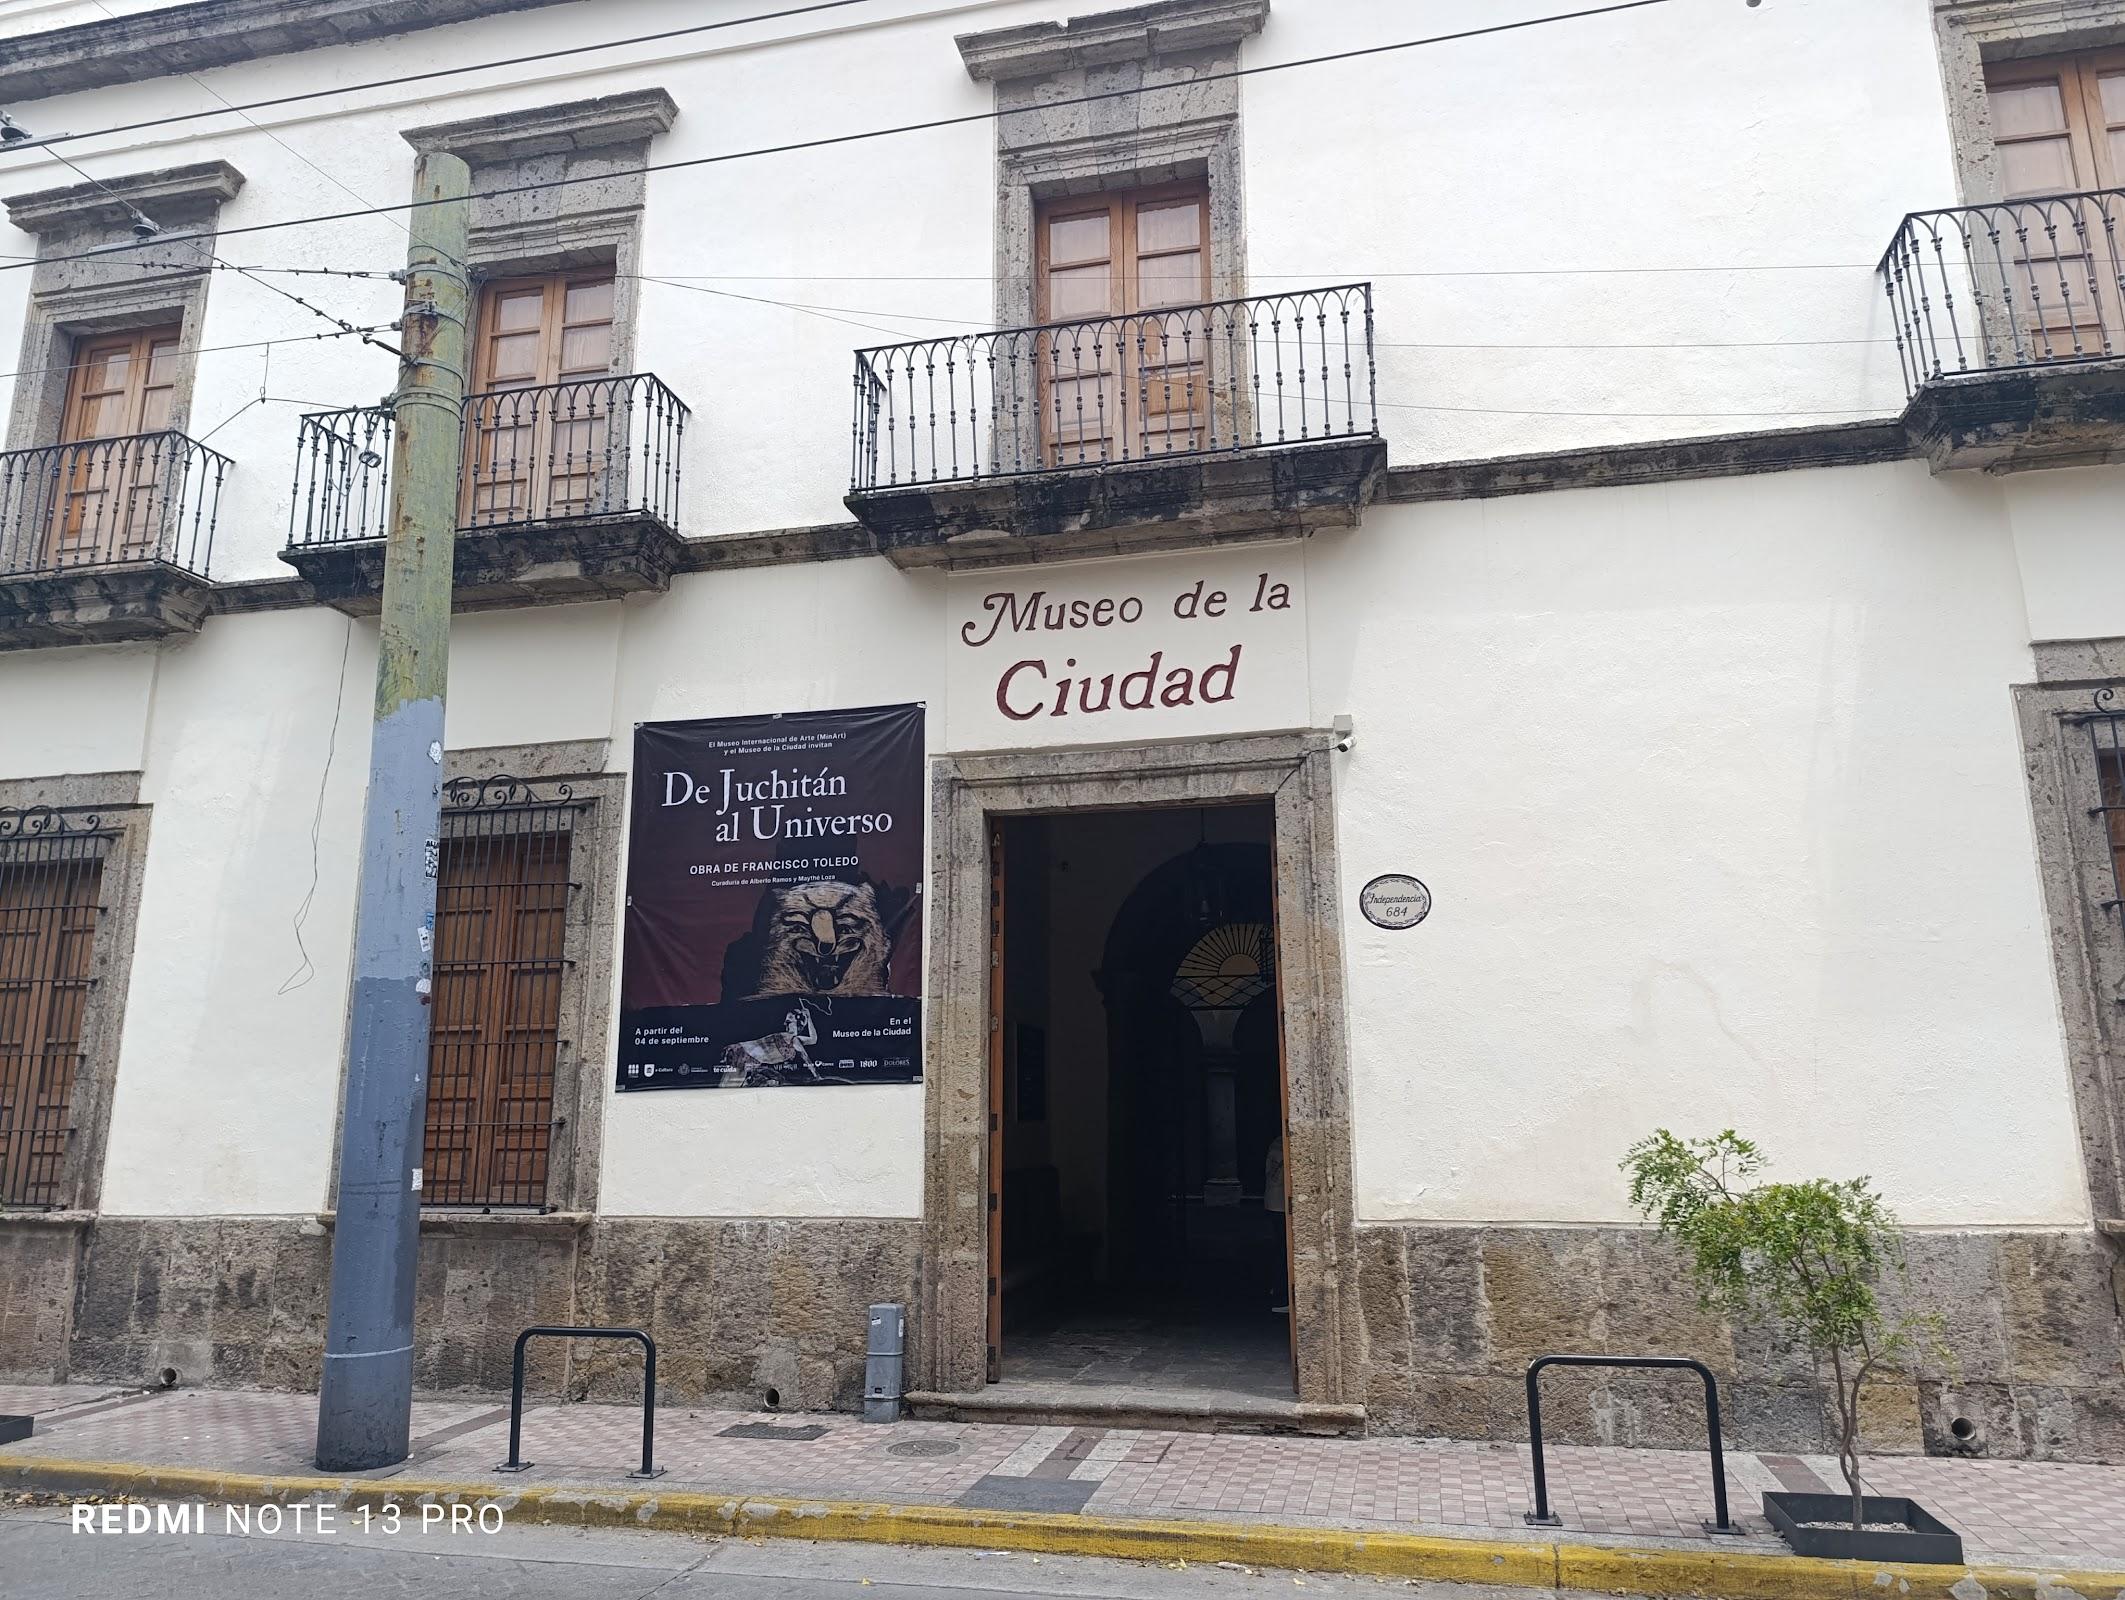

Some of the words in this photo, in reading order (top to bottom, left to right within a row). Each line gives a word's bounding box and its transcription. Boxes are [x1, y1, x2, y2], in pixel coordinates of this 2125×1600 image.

[962, 591, 1143, 647] Museo
[1174, 580, 1228, 619] de
[1249, 572, 1291, 612] la
[996, 644, 1242, 721] Ciudad
[717, 740, 740, 748] Museo
[741, 736, 787, 746] Internacional
[800, 734, 815, 742] Arte
[817, 732, 847, 741] (MinArt)
[730, 746, 737, 754] el
[781, 743, 807, 751] Ciudad
[808, 741, 833, 749] invitan
[661, 771, 711, 807] De
[715, 767, 847, 816] Juchitán
[715, 811, 740, 842] al
[750, 804, 893, 840] Universo
[689, 864, 721, 875] OBRA
[724, 863, 739, 873] DE
[742, 859, 809, 872] FRANCISCO
[813, 856, 859, 868] TOLEDO
[750, 876, 772, 885] Alberto
[772, 876, 792, 884] Ramos
[821, 873, 836, 881] Loza
[1369, 893, 1421, 906] Independencia
[1385, 906, 1408, 917] 684
[889, 1017, 901, 1026] En
[903, 1016, 912, 1025] el
[643, 1027, 668, 1036] partir
[669, 1026, 683, 1034] del
[832, 1030, 860, 1038] Museo
[861, 1029, 872, 1037] de
[873, 1028, 881, 1036] la
[882, 1027, 912, 1036] Ciudad
[634, 1037, 646, 1045] 04
[648, 1037, 659, 1045] de
[661, 1036, 709, 1045] septiembre
[860, 1059, 878, 1068] 1800
